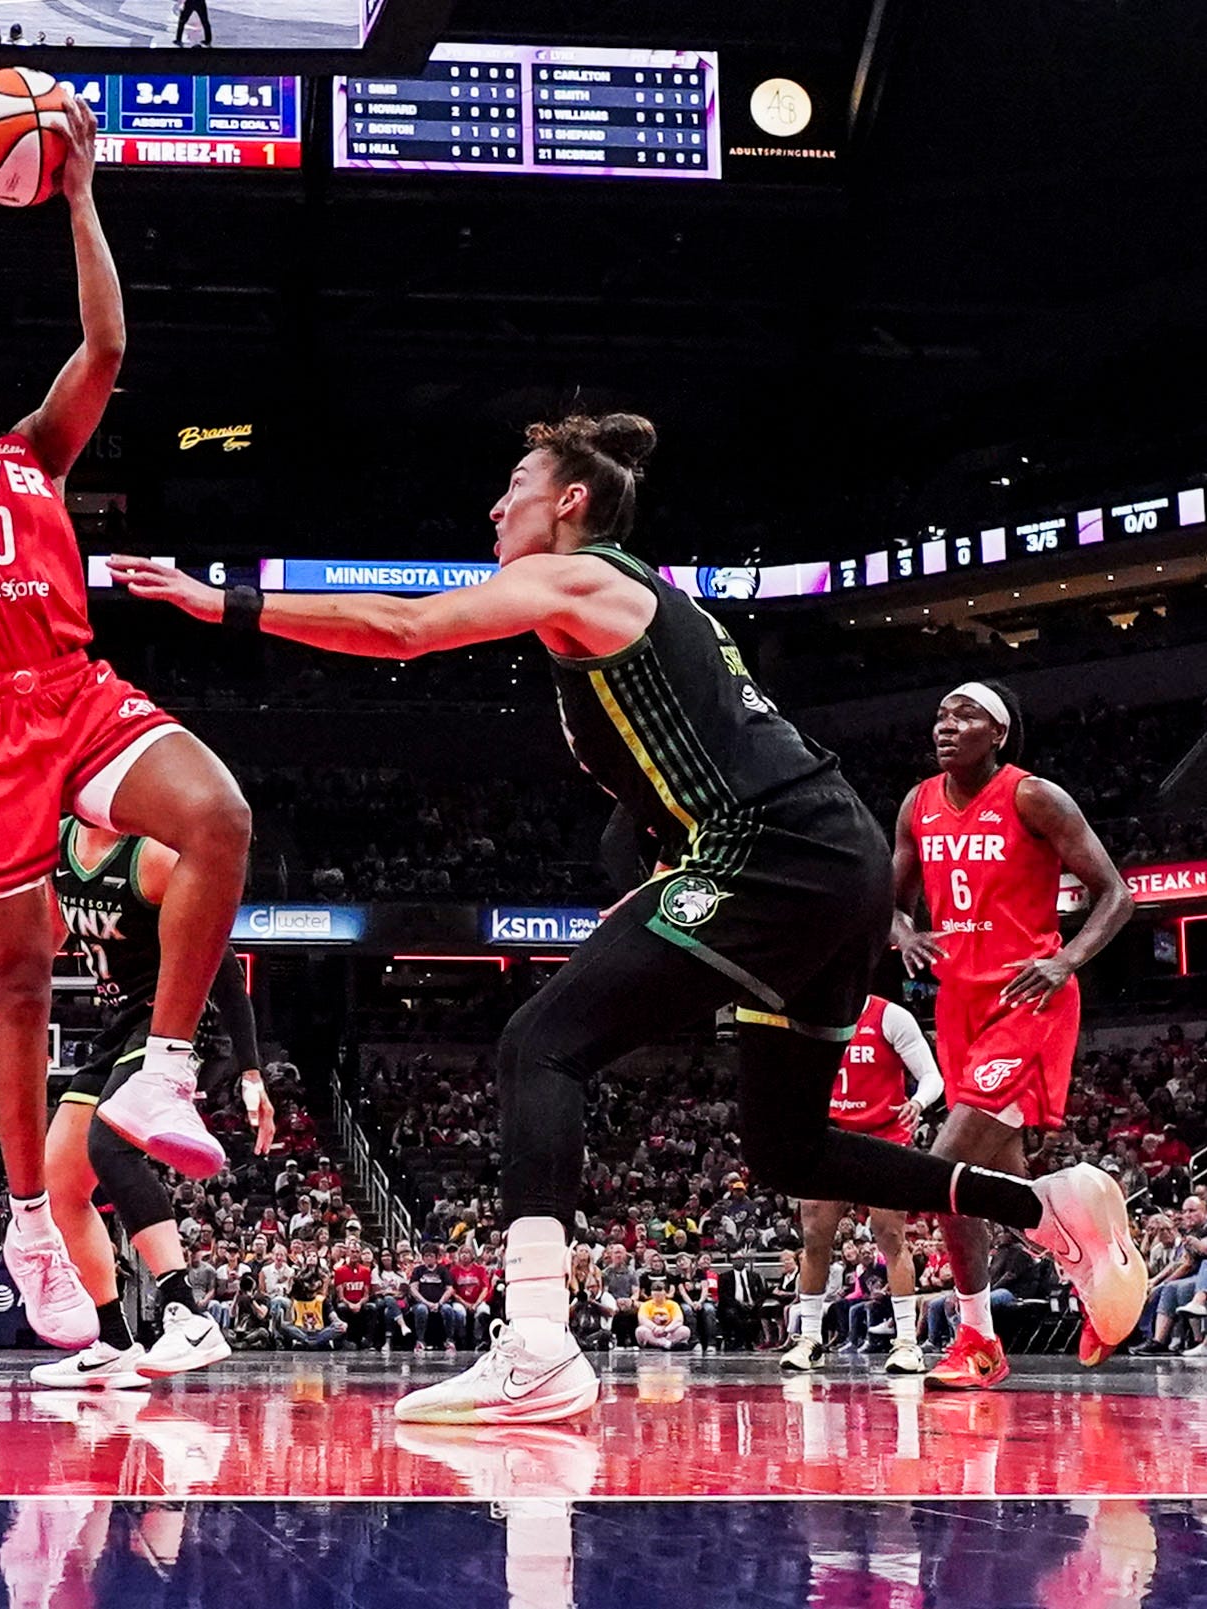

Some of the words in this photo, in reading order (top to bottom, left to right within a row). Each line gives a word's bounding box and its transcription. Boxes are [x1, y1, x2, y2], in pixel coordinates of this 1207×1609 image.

[451, 66, 459, 77] 0
[470, 67, 479, 78] 0
[489, 68, 499, 78] 0
[505, 68, 514, 78] 0
[655, 73, 662, 83] 1
[136, 83, 179, 104] 3.4
[215, 85, 272, 106] 45.1
[355, 84, 362, 94] 1
[451, 86, 460, 97] 0
[471, 87, 479, 98] 0
[491, 88, 497, 98] 1
[554, 90, 589, 101] SMITH
[675, 94, 681, 104] 1
[451, 106, 460, 116] 2
[555, 110, 609, 122] WILLIAMS
[355, 123, 363, 134] 7
[369, 124, 414, 135] BOSTON
[472, 127, 479, 137] 1
[657, 132, 663, 142] 1
[677, 133, 683, 143] 1
[136, 141, 241, 164] THREEZ-IT:
[263, 144, 275, 164] 1
[369, 144, 399, 154] HULL
[492, 147, 499, 158] 1
[178, 424, 253, 450] Branson
[1125, 511, 1157, 532] 0/0
[1027, 531, 1057, 552] 3/5
[958, 548, 970, 564] 0
[208, 562, 225, 585] 6
[900, 559, 911, 576] 3
[326, 566, 439, 586] MINNESOTA
[443, 568, 491, 588] LYNX
[843, 570, 855, 587] 2
[921, 834, 1007, 862] FEVER
[951, 868, 971, 911] 6
[1127, 870, 1191, 894] STEAK
[278, 914, 329, 932] water
[493, 909, 558, 938] ksm
